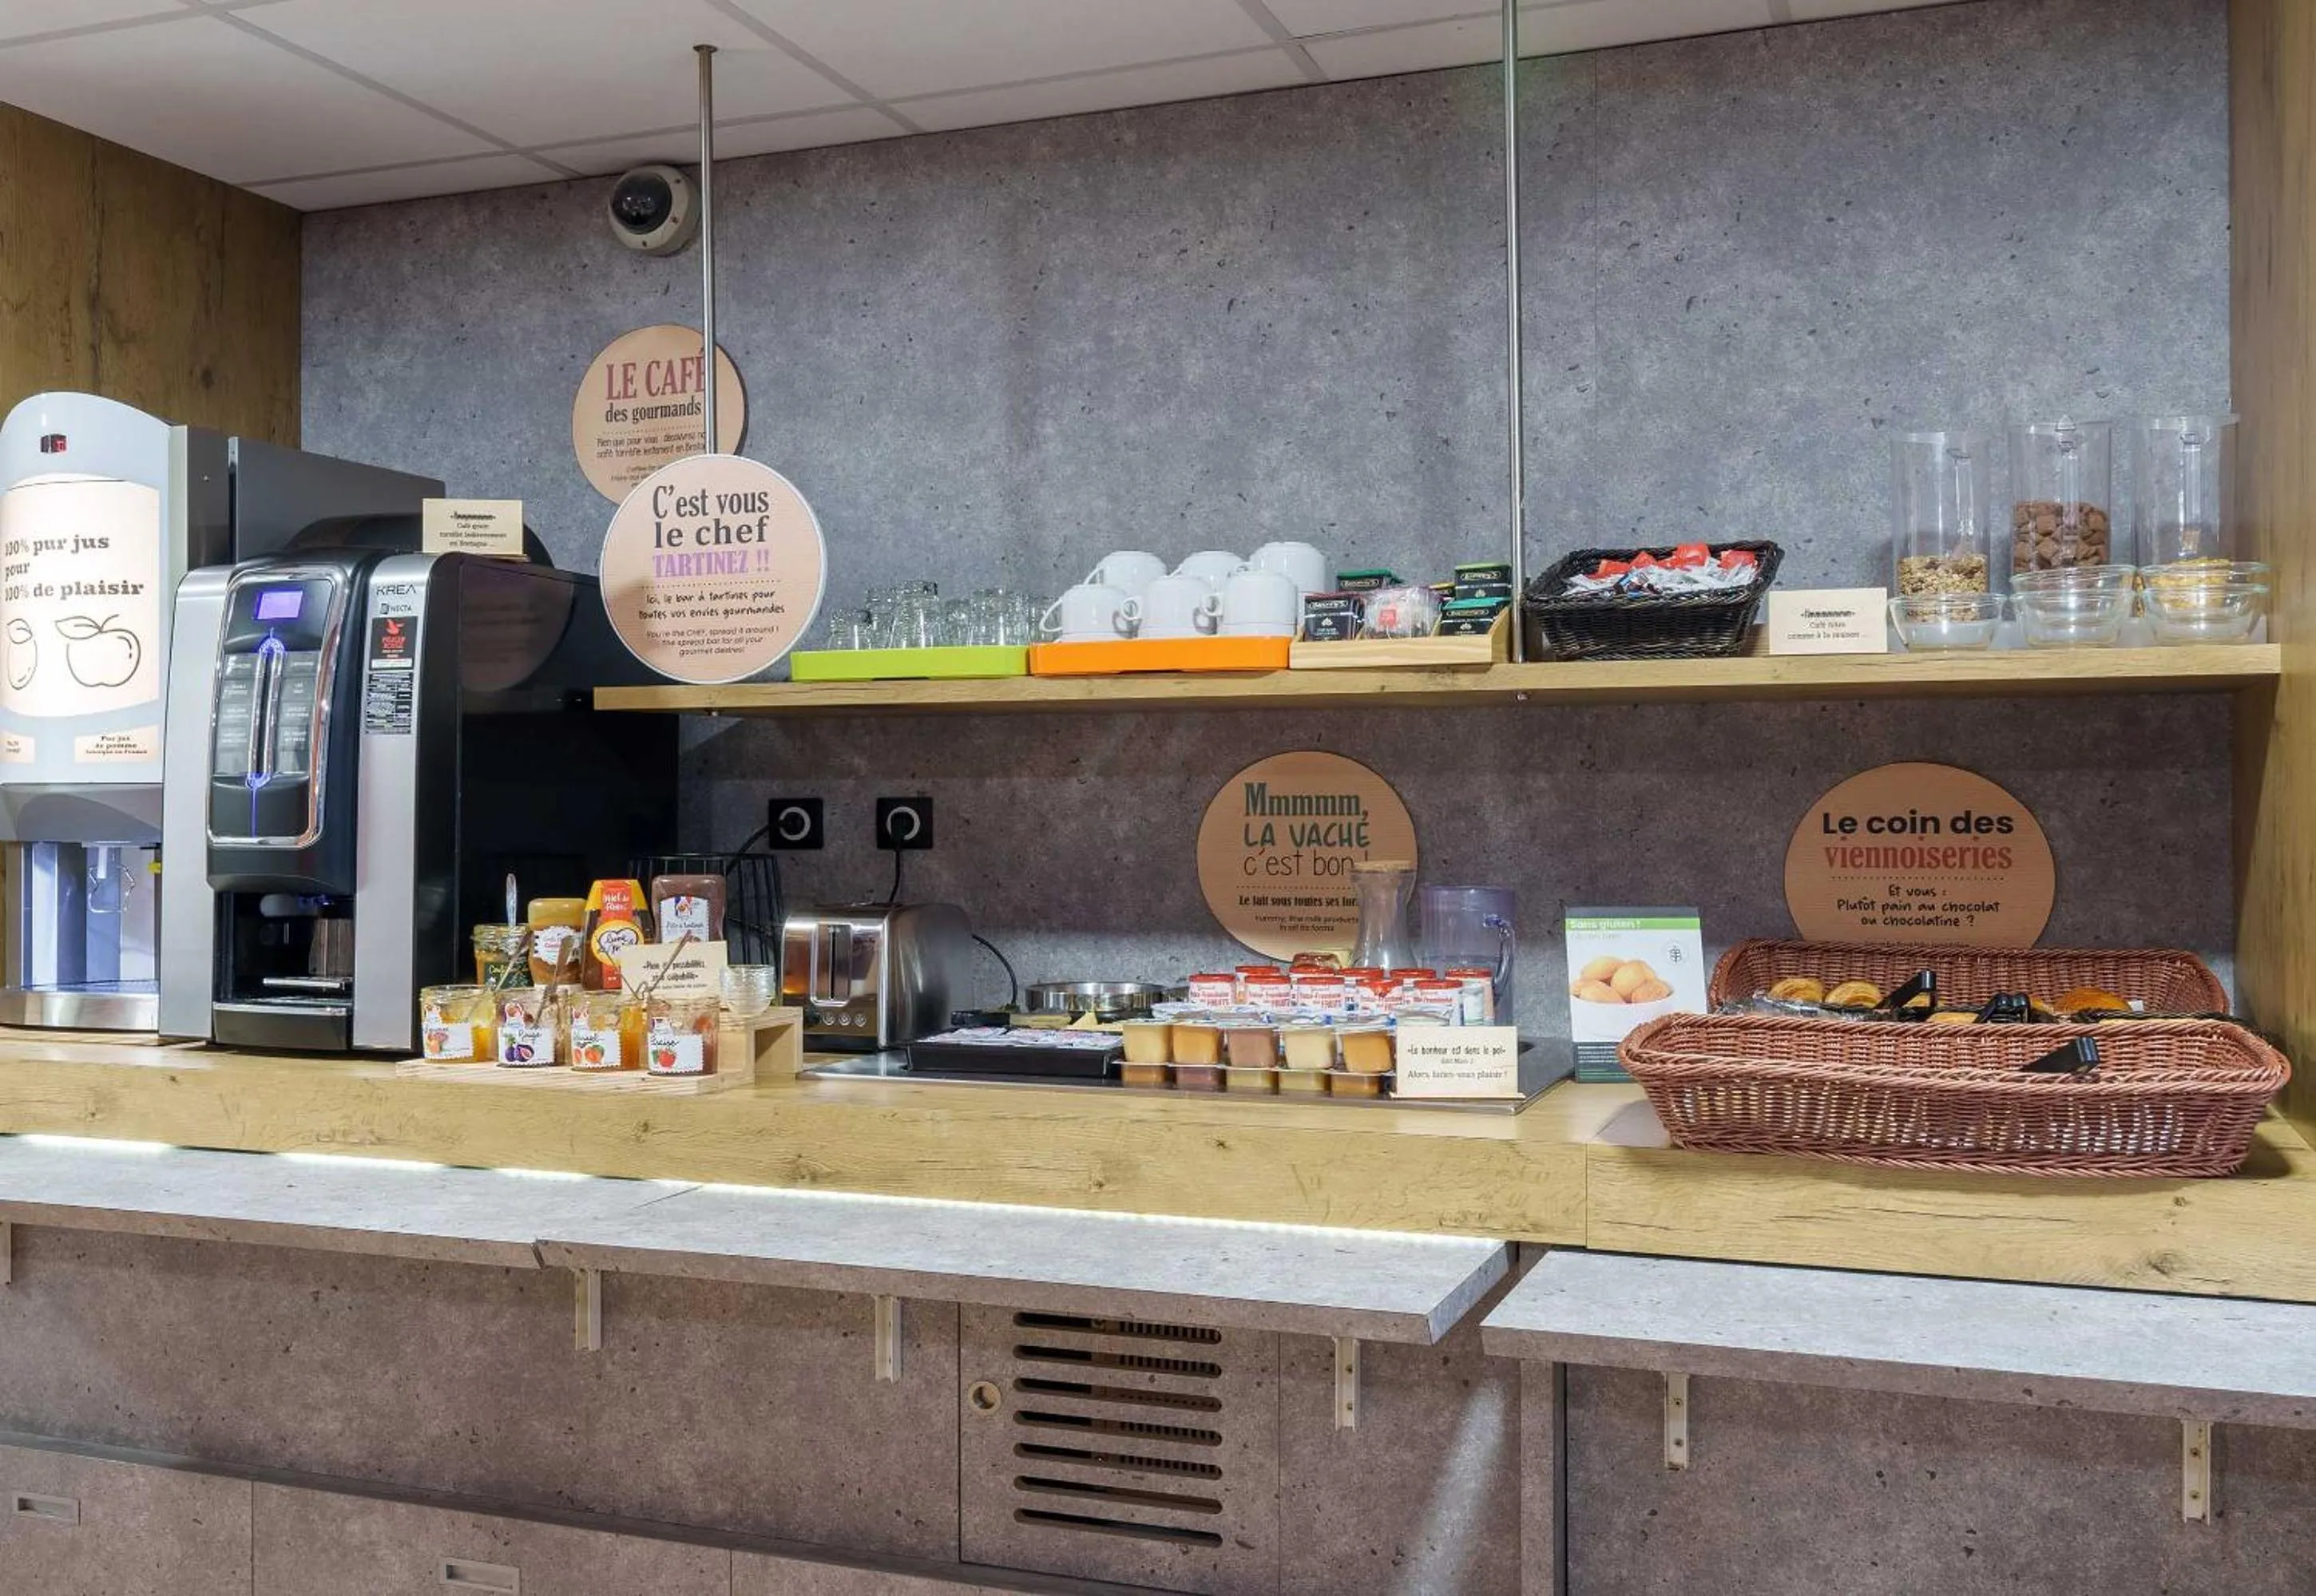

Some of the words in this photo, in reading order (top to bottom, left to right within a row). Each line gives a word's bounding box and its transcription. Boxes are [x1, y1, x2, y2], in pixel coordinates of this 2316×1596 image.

[605, 362, 637, 400] LE
[605, 402, 628, 424] des
[632, 394, 702, 425] gourmands
[652, 484, 709, 520] C'est
[716, 491, 770, 515] vous
[654, 521, 684, 549] le
[695, 515, 770, 546] chef
[33, 537, 68, 556] pur
[70, 533, 110, 554] jus
[4, 561, 30, 582] pour
[652, 549, 749, 578] TARTINEZ
[33, 583, 55, 598] de
[60, 580, 145, 600] plaisir
[376, 584, 417, 596] KREA
[663, 595, 672, 604] le
[676, 593, 694, 603] bar
[708, 591, 748, 600] tartines
[752, 590, 775, 603] pour
[639, 610, 668, 620] toutes
[670, 610, 686, 619] vos
[689, 607, 719, 618] envies
[722, 604, 785, 620] gourmandes
[1822, 812, 1858, 834] Le
[1866, 809, 1941, 834] coin
[1949, 810, 2014, 834] des
[1244, 822, 1276, 848] LA
[1288, 821, 1371, 848] VACHE
[1243, 849, 1304, 877] c'est
[1313, 849, 1355, 876] bon
[1823, 836, 2013, 869] viennoiseries
[1239, 895, 1251, 906] Le
[1888, 884, 1902, 897] Et
[1906, 886, 1937, 897] vous
[1837, 896, 1877, 912] Plutôt
[1881, 901, 1913, 915] pain
[1917, 902, 1936, 912] au
[1941, 901, 2001, 913] chocolat
[1861, 917, 1877, 926] ou
[1882, 915, 1961, 927] chocolatine
